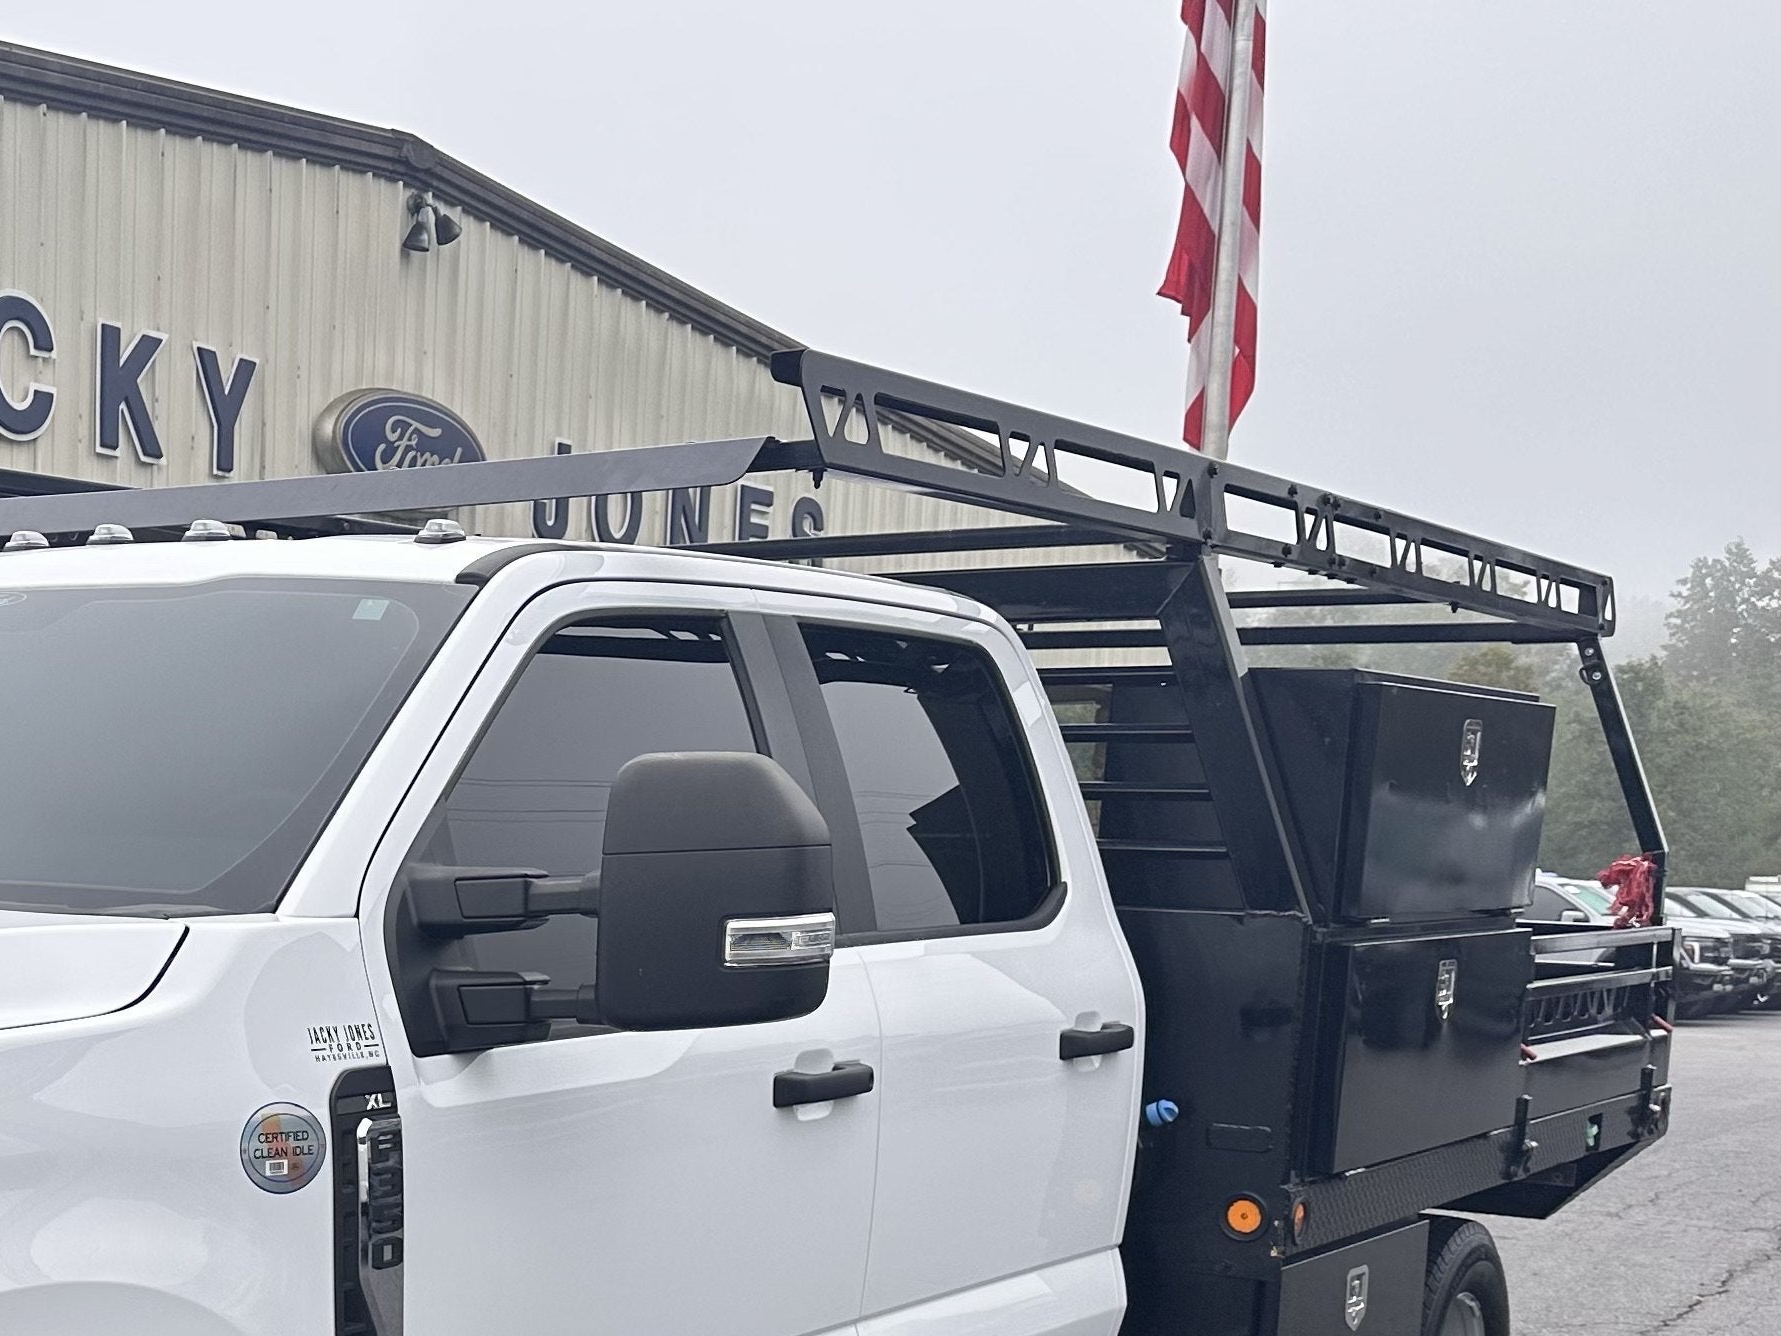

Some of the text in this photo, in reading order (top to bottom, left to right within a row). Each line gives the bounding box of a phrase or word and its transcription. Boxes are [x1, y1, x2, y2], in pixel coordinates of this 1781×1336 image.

[307, 1023, 376, 1045] JACKY JONES
[329, 1042, 362, 1053] FORD
[364, 1093, 392, 1111] XL
[257, 1130, 310, 1144] CERTIFIED
[253, 1145, 315, 1160] CLEAN IDLE
